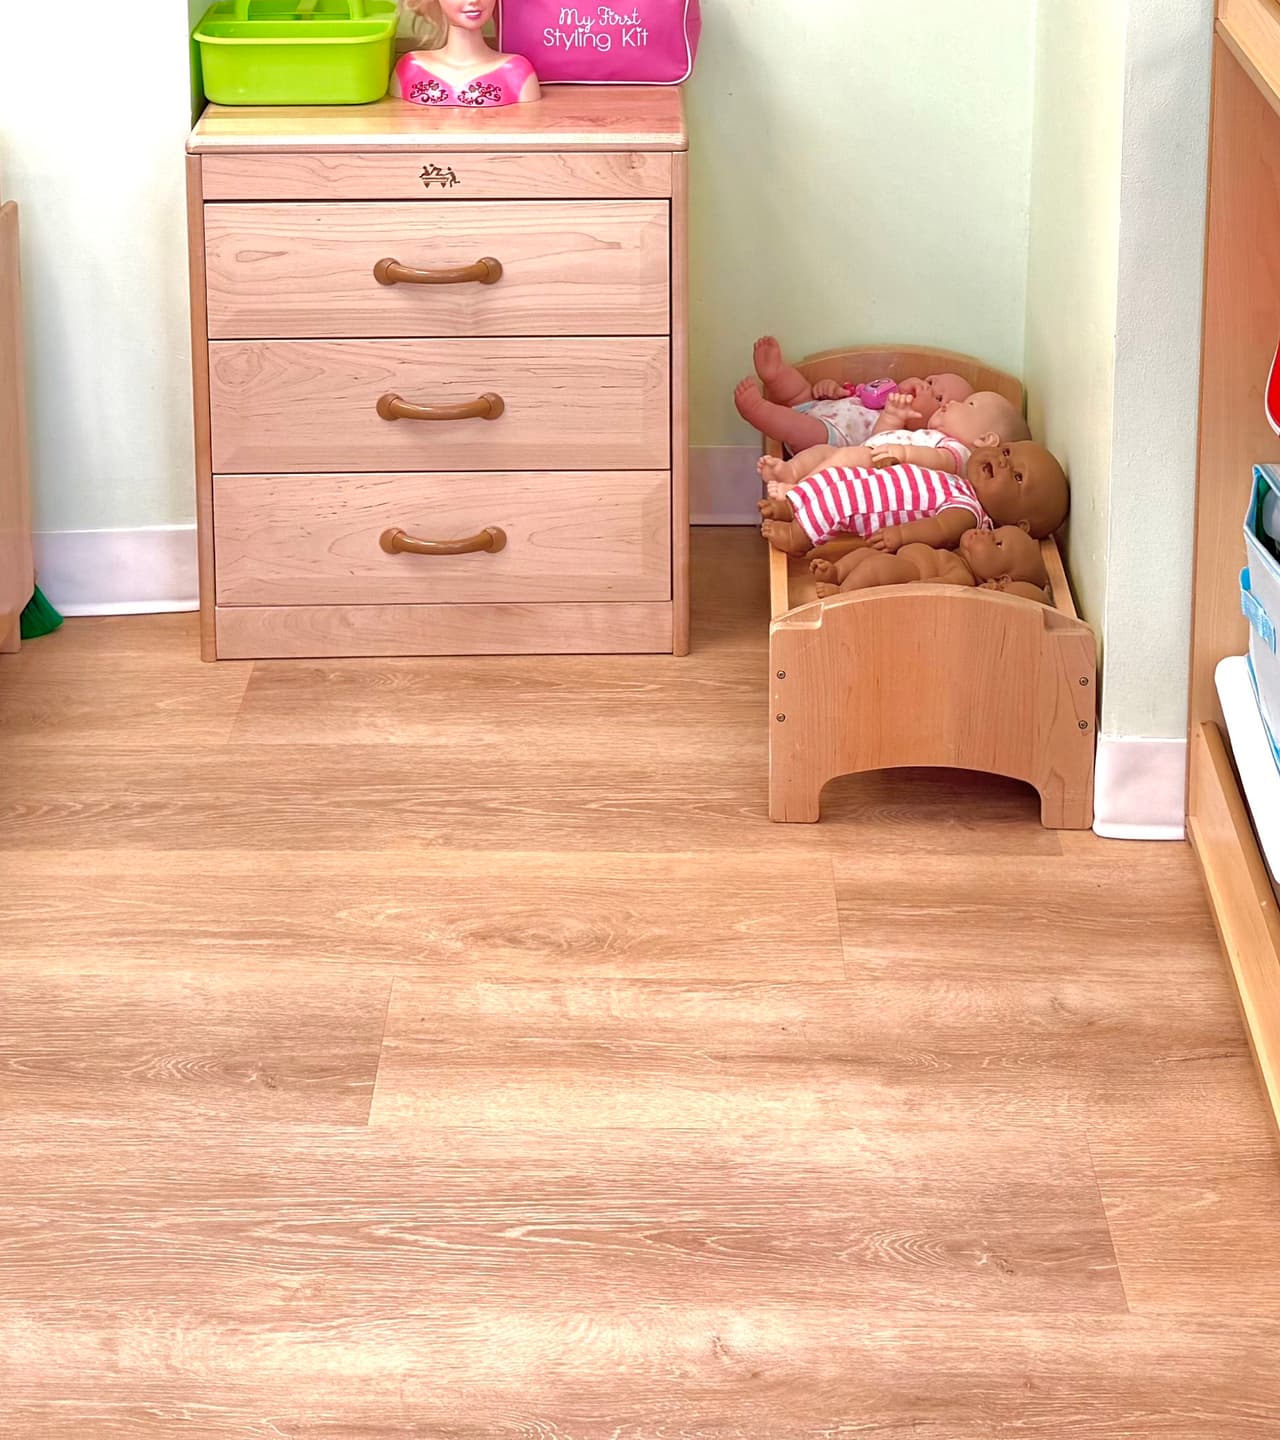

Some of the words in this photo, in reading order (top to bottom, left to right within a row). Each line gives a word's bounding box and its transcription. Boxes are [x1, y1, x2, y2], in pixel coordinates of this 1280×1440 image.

[558, 7, 596, 32] My
[597, 6, 642, 27] First
[543, 27, 611, 51] Styling
[622, 26, 649, 48] Kit
